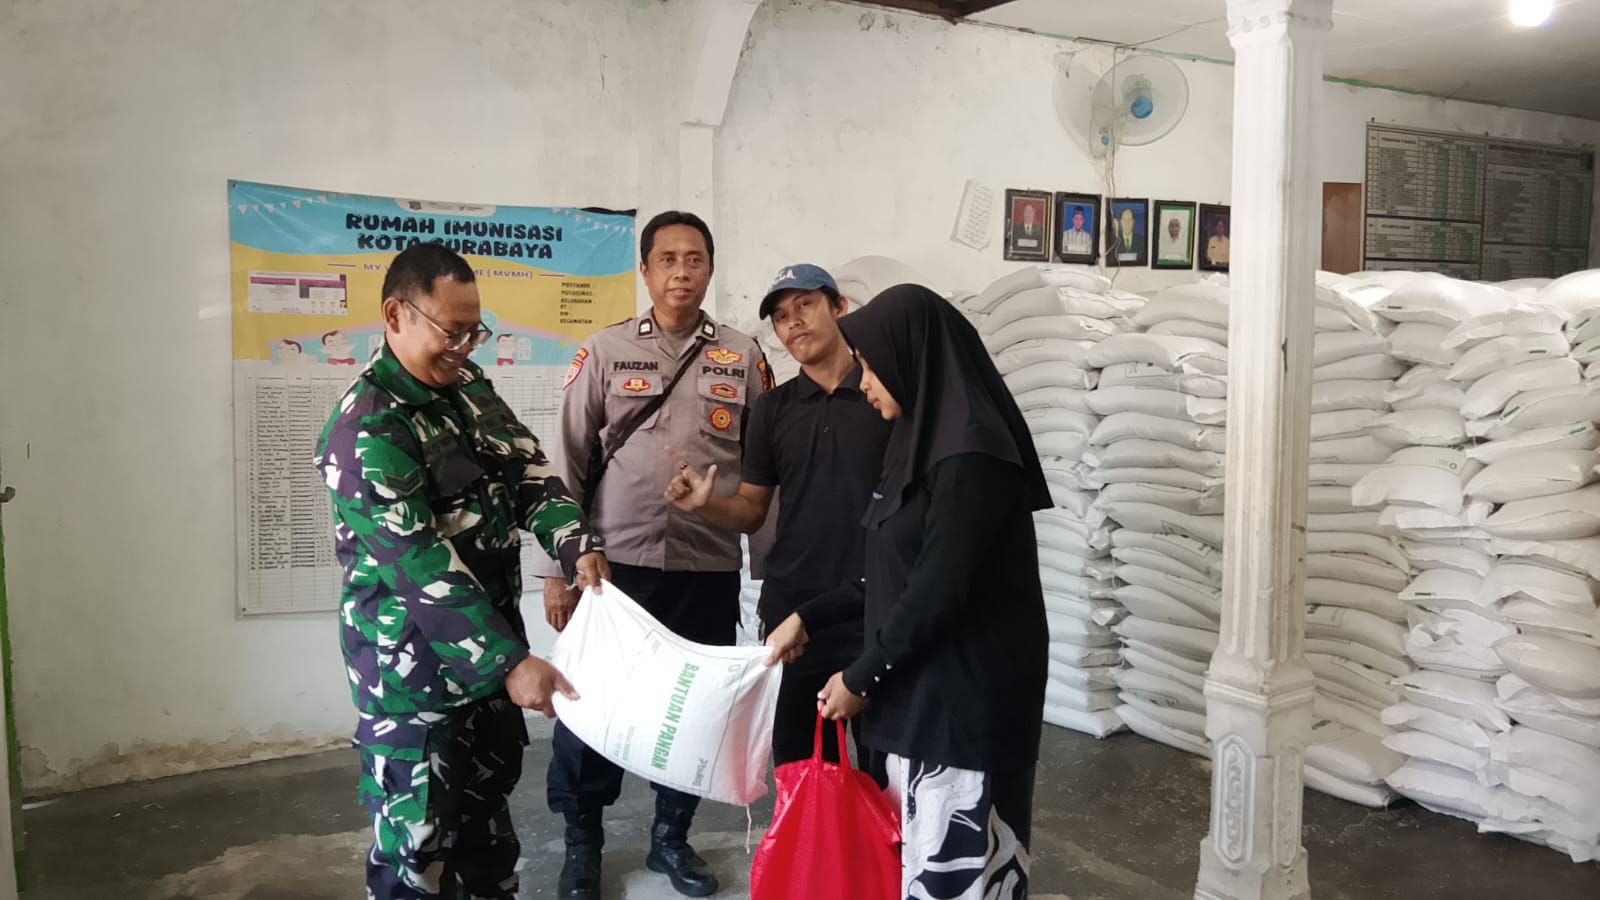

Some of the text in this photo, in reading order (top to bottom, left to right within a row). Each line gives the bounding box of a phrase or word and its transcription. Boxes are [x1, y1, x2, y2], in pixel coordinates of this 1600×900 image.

[346, 213, 562, 242] RUMAH IMUNISASI
[613, 361, 658, 372] FAUZAN
[702, 366, 745, 378] POLRI
[650, 662, 700, 771] BANTUAN PANGAN
